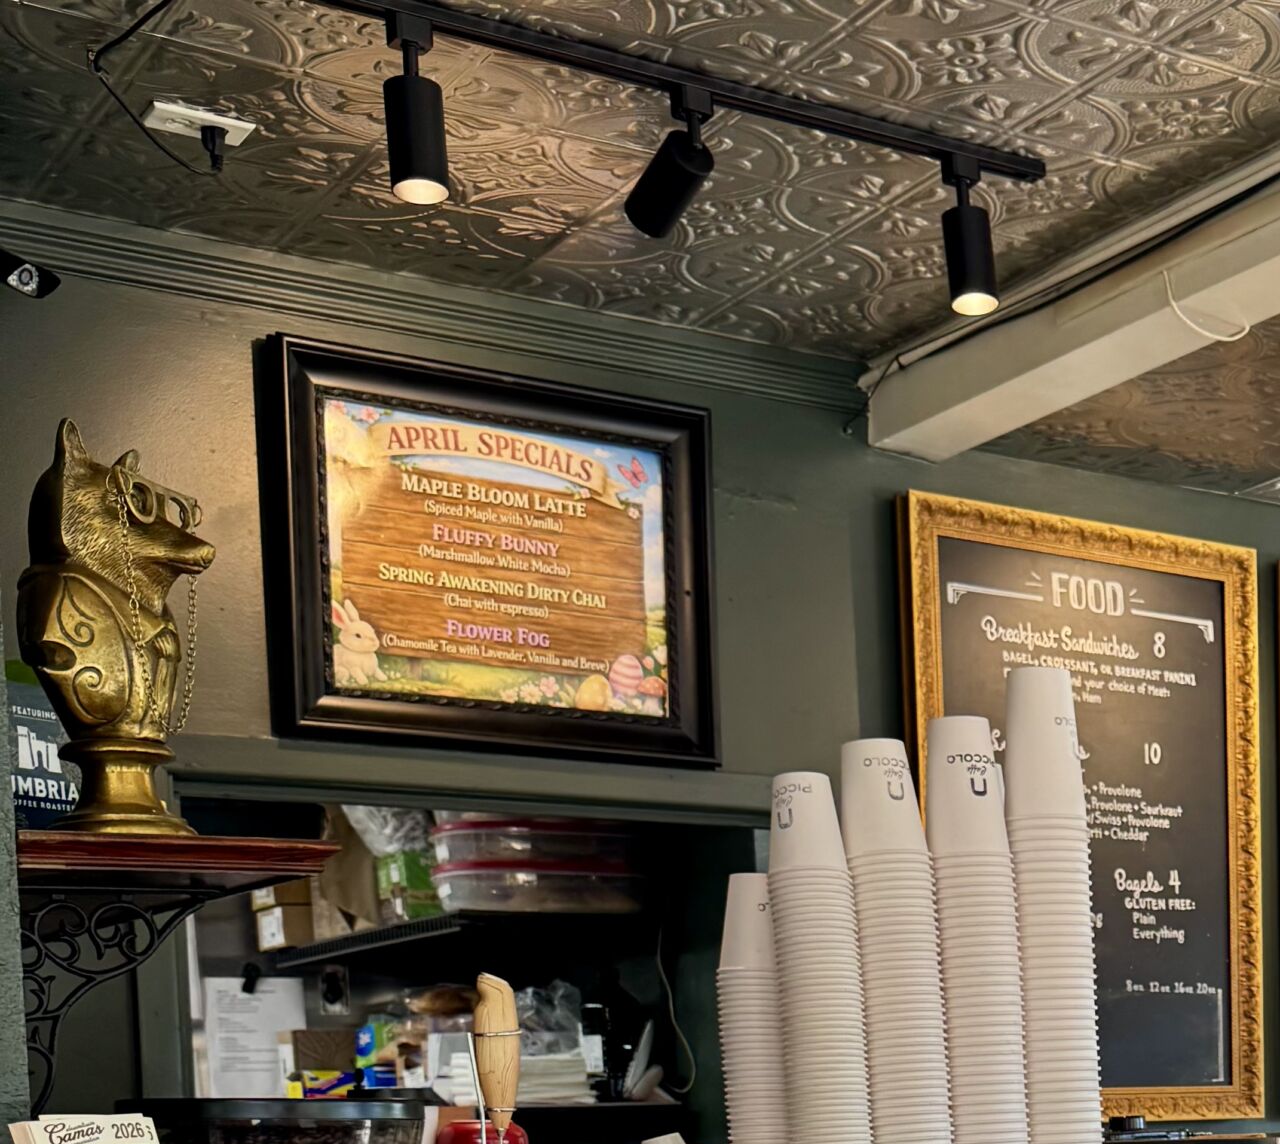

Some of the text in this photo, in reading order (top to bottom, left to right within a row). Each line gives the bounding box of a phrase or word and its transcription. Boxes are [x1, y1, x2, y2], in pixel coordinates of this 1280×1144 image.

[388, 426, 594, 483] APRIL SPECIALS
[401, 473, 587, 518] MAPLE BLOOM LATTE
[424, 500, 563, 533] (Spiced Maple with Vanilla)
[432, 523, 559, 557] FLUFFY BUNNY
[419, 544, 571, 578] (Marshmallow White Mocha)
[379, 562, 607, 609] SPRING AWAKENING DIRTY CHAI
[1051, 571, 1125, 617] FOOD
[444, 593, 549, 619] (Chai with espresso)
[447, 620, 550, 648] FLOWER FOG
[981, 615, 1166, 660] Breakfast Sandwiches 8
[383, 633, 610, 673] (Chamomile Tea with Lavender, Vanilla and Breve)
[1002, 650, 1039, 667] BAGEL,
[1115, 666, 1162, 681] BREAKFAST
[1084, 680, 1105, 691] your
[1108, 681, 1135, 694] choice
[1137, 684, 1147, 695] of
[12, 705, 57, 720] FEATURING
[1144, 742, 1161, 765] 10
[13, 800, 76, 812] OFFEE ROASTE
[1110, 827, 1149, 841] Cheddar
[1114, 868, 1181, 898] Bagels 4
[1124, 897, 1196, 910] GLUTEN FREE:
[1133, 911, 1156, 925] Plain
[1133, 925, 1185, 944] Everything
[111, 1122, 145, 1139] 2026
